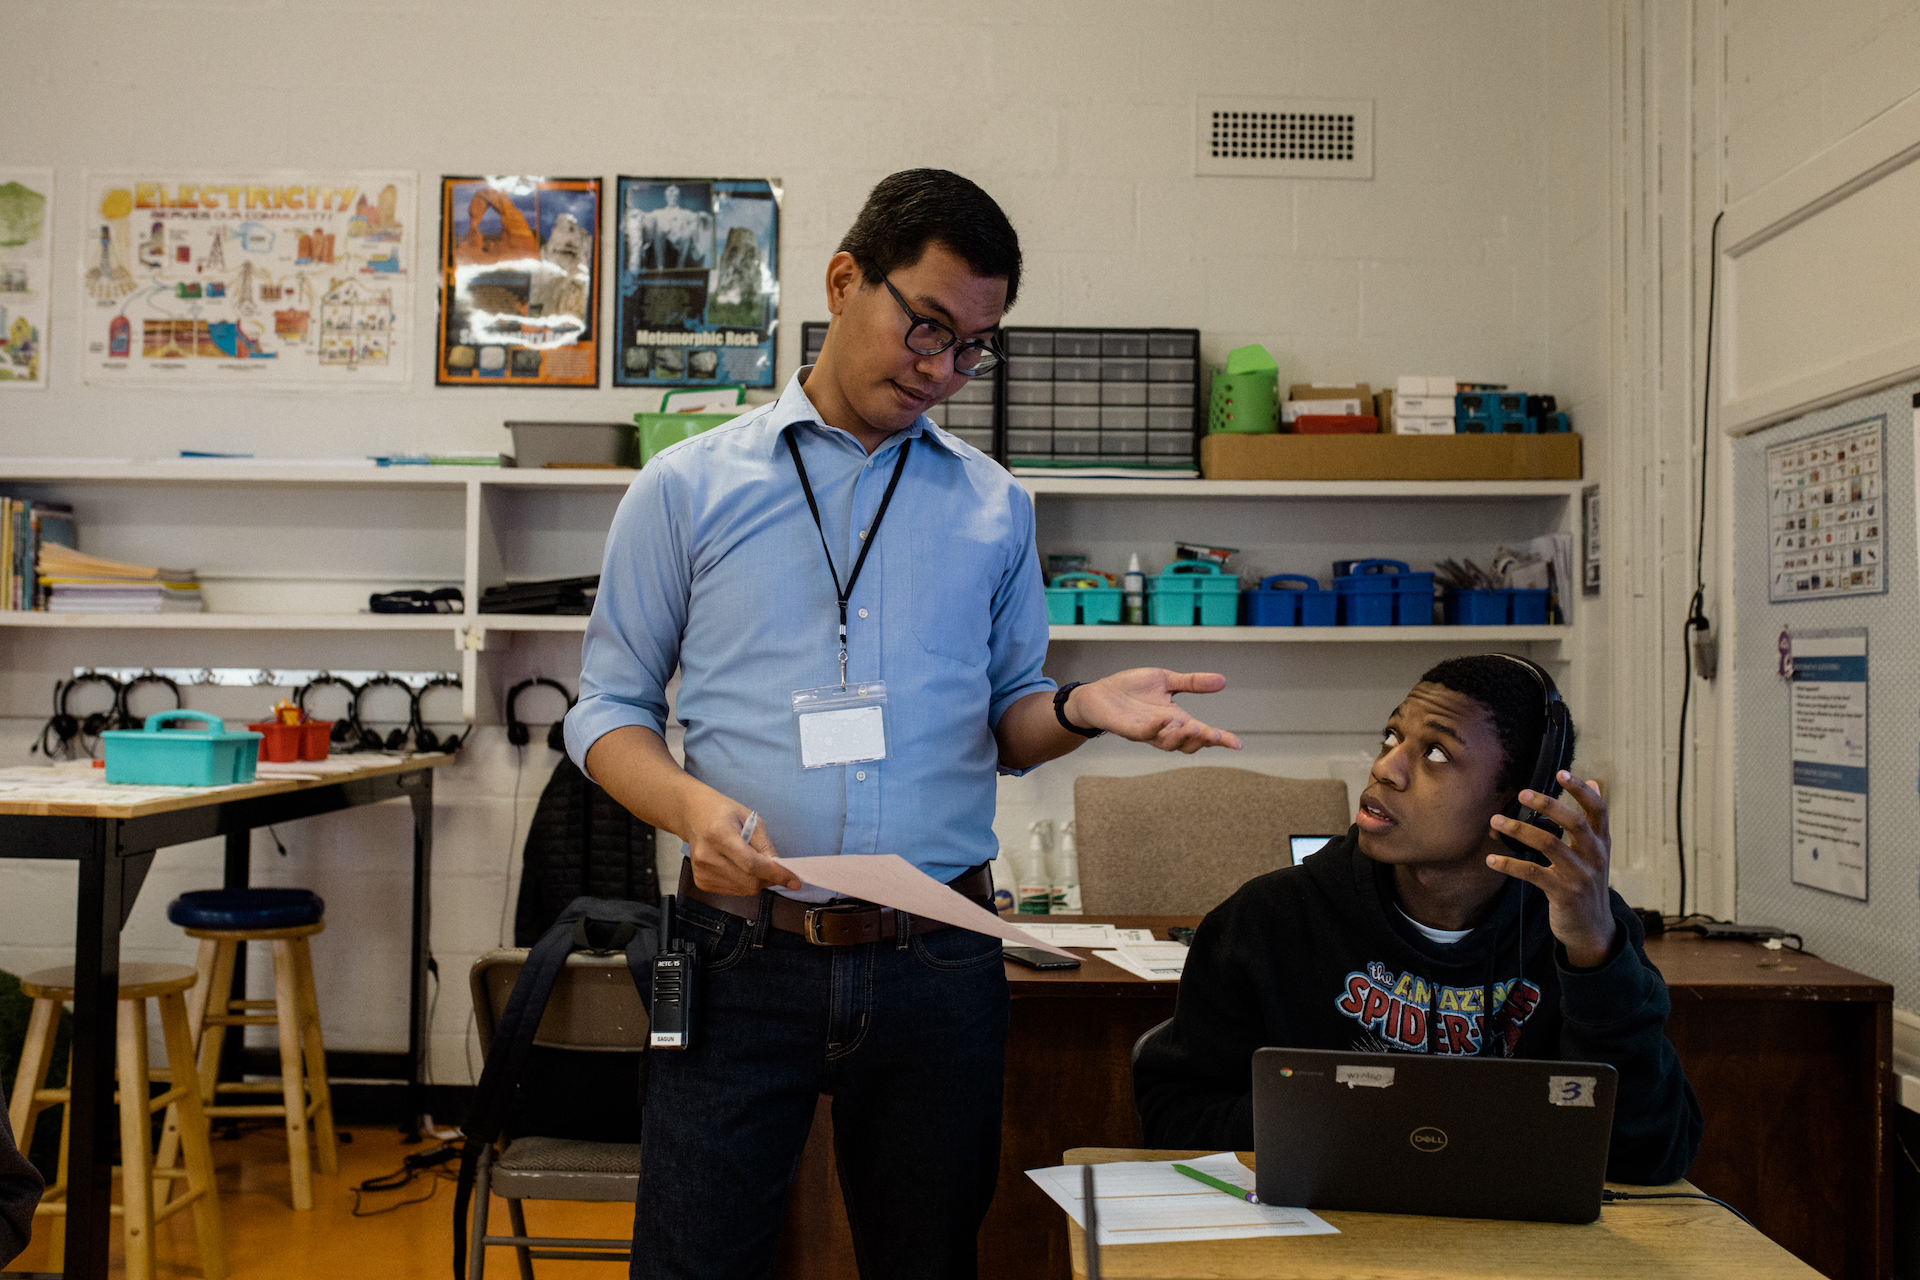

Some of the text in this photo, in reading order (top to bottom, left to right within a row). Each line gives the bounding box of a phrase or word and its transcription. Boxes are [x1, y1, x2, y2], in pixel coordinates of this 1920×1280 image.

[134, 183, 357, 212] ELECTRICITY
[636, 330, 759, 347] Metamorphic Rock
[1368, 963, 1394, 986] the
[1561, 1081, 1582, 1101] 3
[1415, 1135, 1444, 1144] DELL
